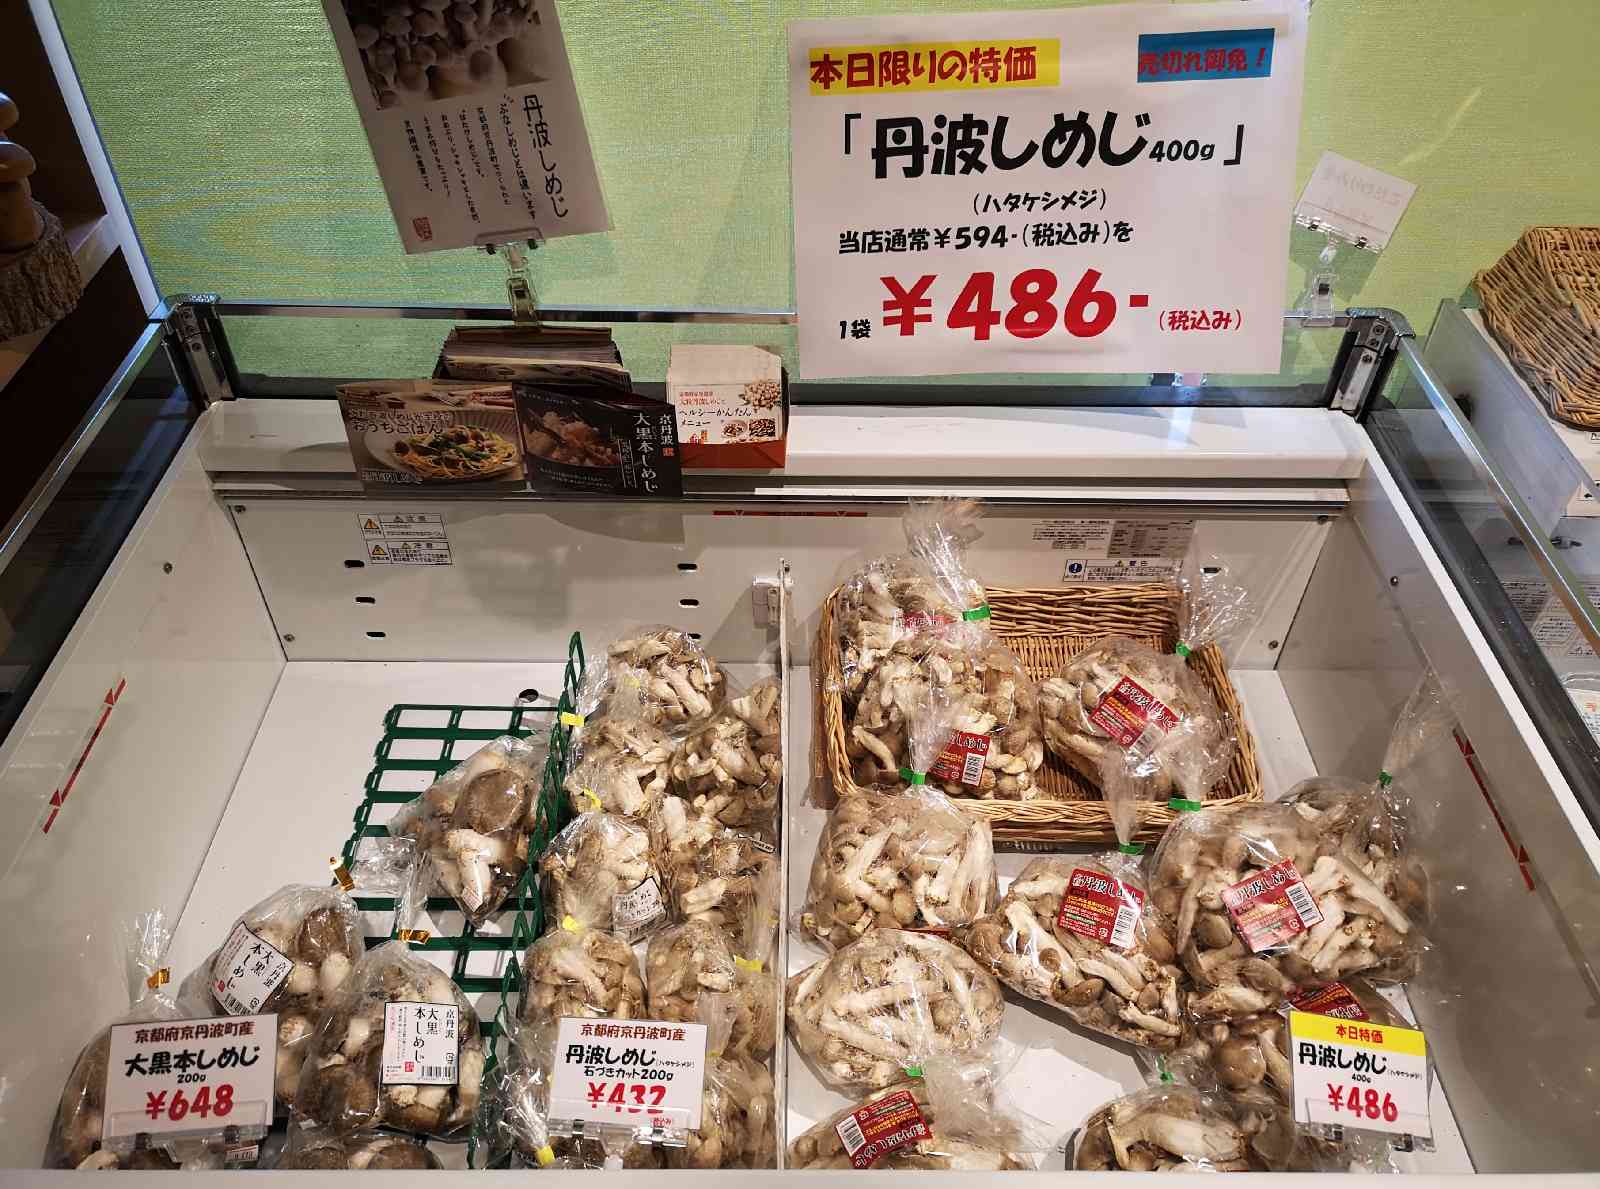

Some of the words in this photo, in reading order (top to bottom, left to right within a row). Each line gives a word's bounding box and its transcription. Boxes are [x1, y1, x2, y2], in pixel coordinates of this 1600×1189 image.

[810, 46, 1038, 90] 本日限りの特価
[523, 94, 569, 219] 丹波しめじ
[839, 319, 872, 340] 1袋
[1158, 308, 1243, 332] (税込み)
[660, 414, 674, 446] 京丹波
[633, 412, 658, 493] 大黒本しめじ
[226, 943, 263, 991] 本しめじ
[135, 1020, 255, 1044] 京都府京丹波町産
[413, 1006, 426, 1064] 本しめじ
[426, 1007, 441, 1036] 大黒
[580, 1023, 687, 1041] 京都府京丹波町産
[1335, 1023, 1384, 1044] 本日特価
[124, 1045, 261, 1078] 大黒本しめじ
[565, 1043, 657, 1067] 丹波しめじ
[1298, 1041, 1388, 1076] 丹波しめじ
[145, 1083, 235, 1121] ¥648
[587, 1081, 667, 1115] ¥432
[1327, 1082, 1399, 1123] ¥486
